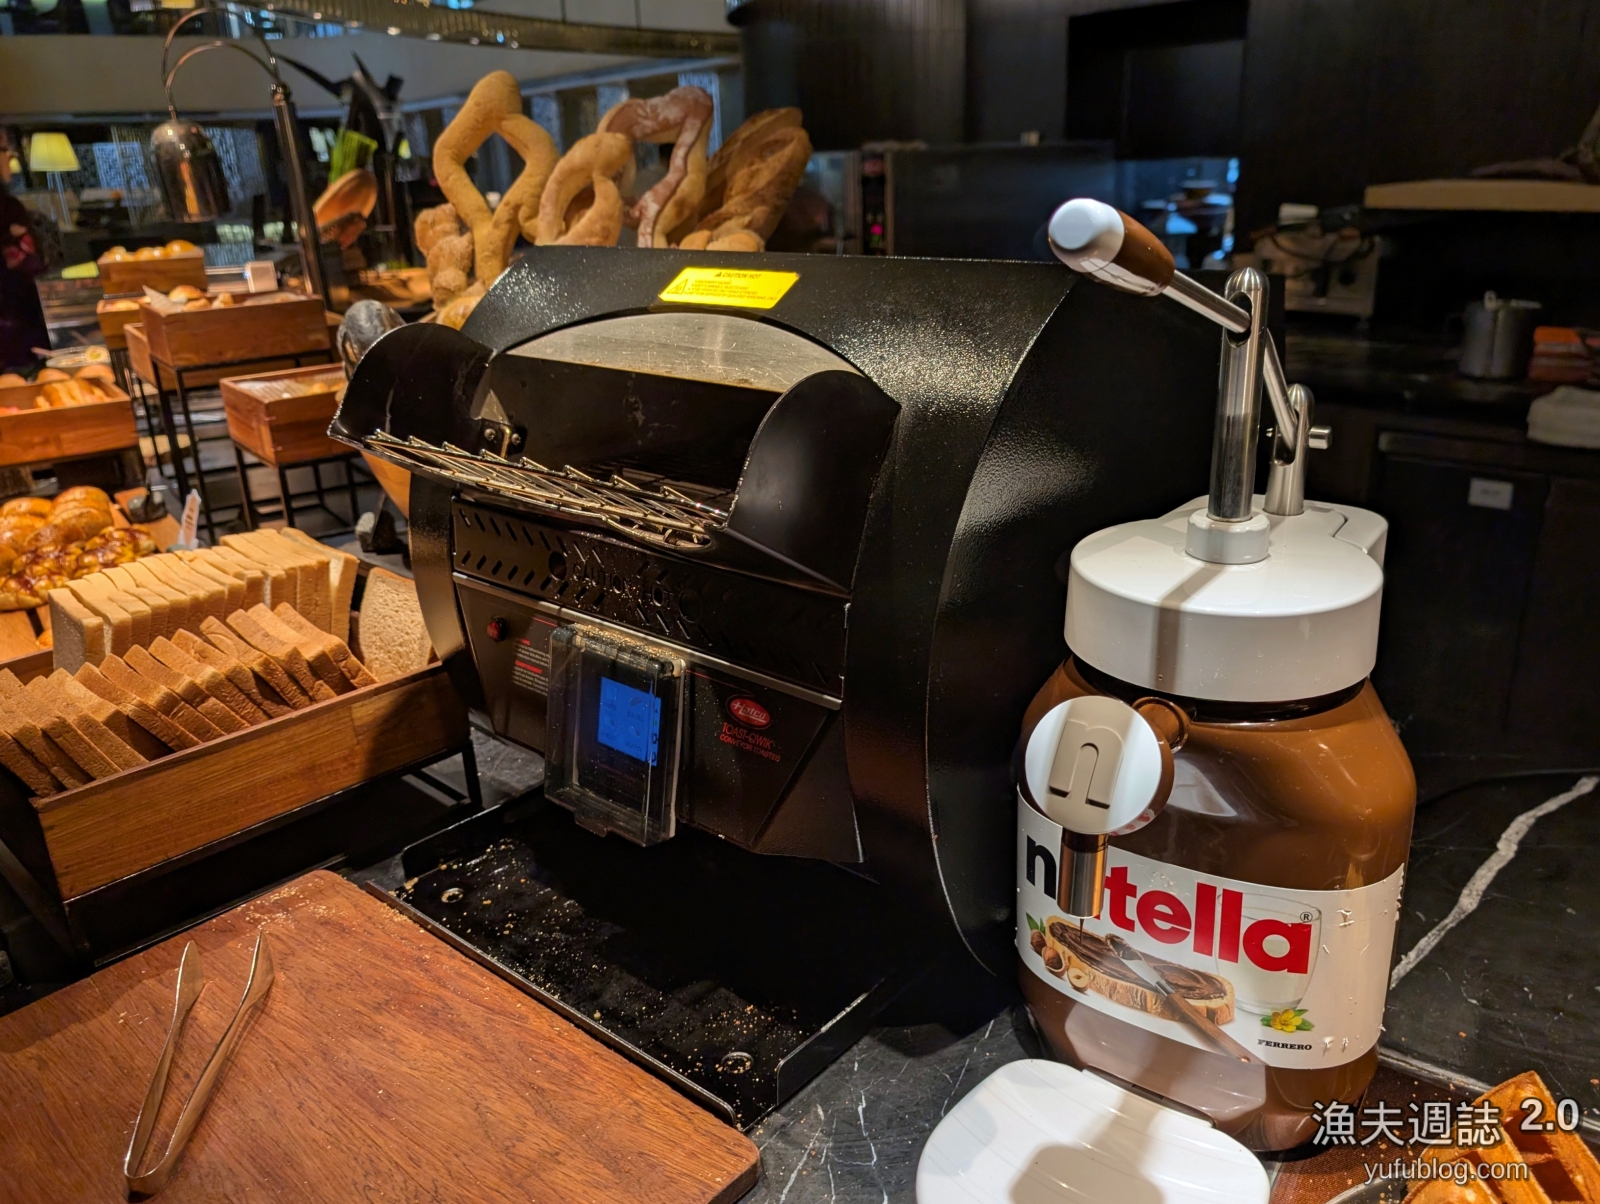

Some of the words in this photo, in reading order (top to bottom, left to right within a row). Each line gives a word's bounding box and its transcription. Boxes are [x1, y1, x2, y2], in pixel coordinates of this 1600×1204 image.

[721, 271, 748, 280] CAUTION
[731, 701, 767, 723] Hatco
[719, 733, 753, 752] CONVEYOR
[753, 746, 781, 762] TOASTER
[722, 721, 772, 749] TOAST-QWIK
[1026, 833, 1313, 975] ntella
[1257, 1038, 1313, 1052] FERRERO
